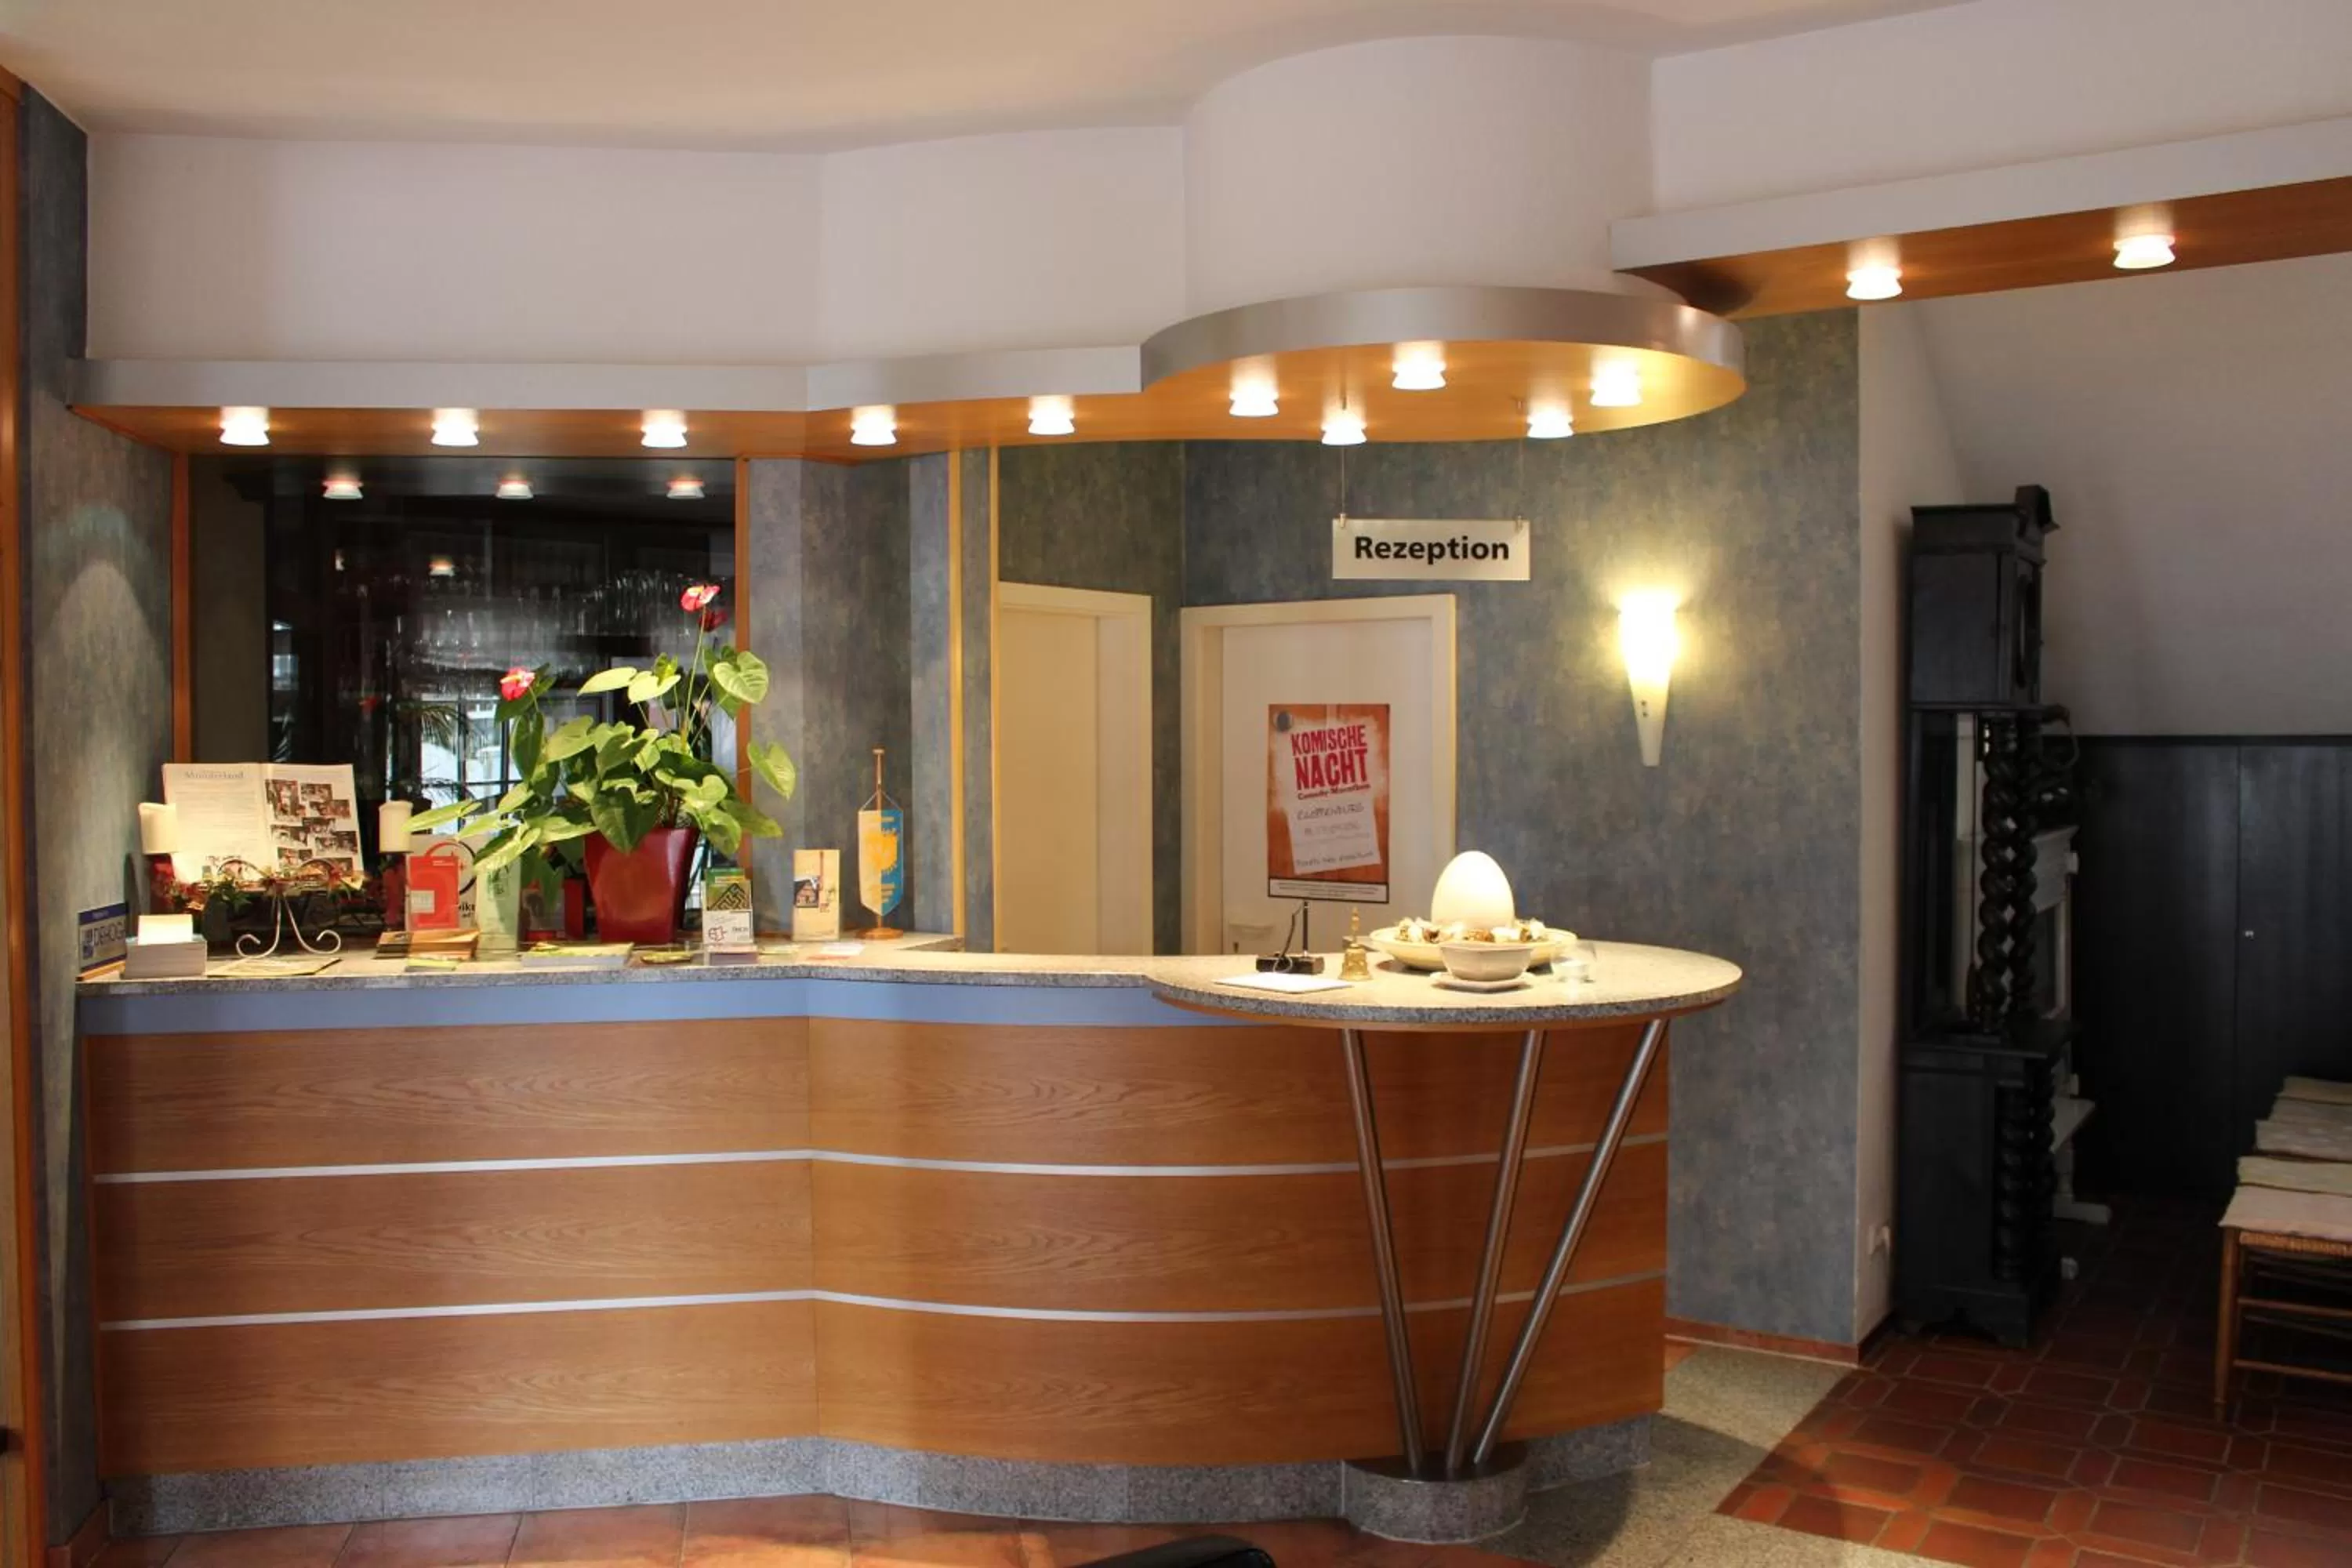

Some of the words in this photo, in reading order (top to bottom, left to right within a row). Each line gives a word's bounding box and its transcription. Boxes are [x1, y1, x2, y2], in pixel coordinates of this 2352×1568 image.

[1355, 535, 1509, 564] Rezeption
[1290, 724, 1368, 756] KOMISCHE
[1294, 748, 1368, 790] NACHT
